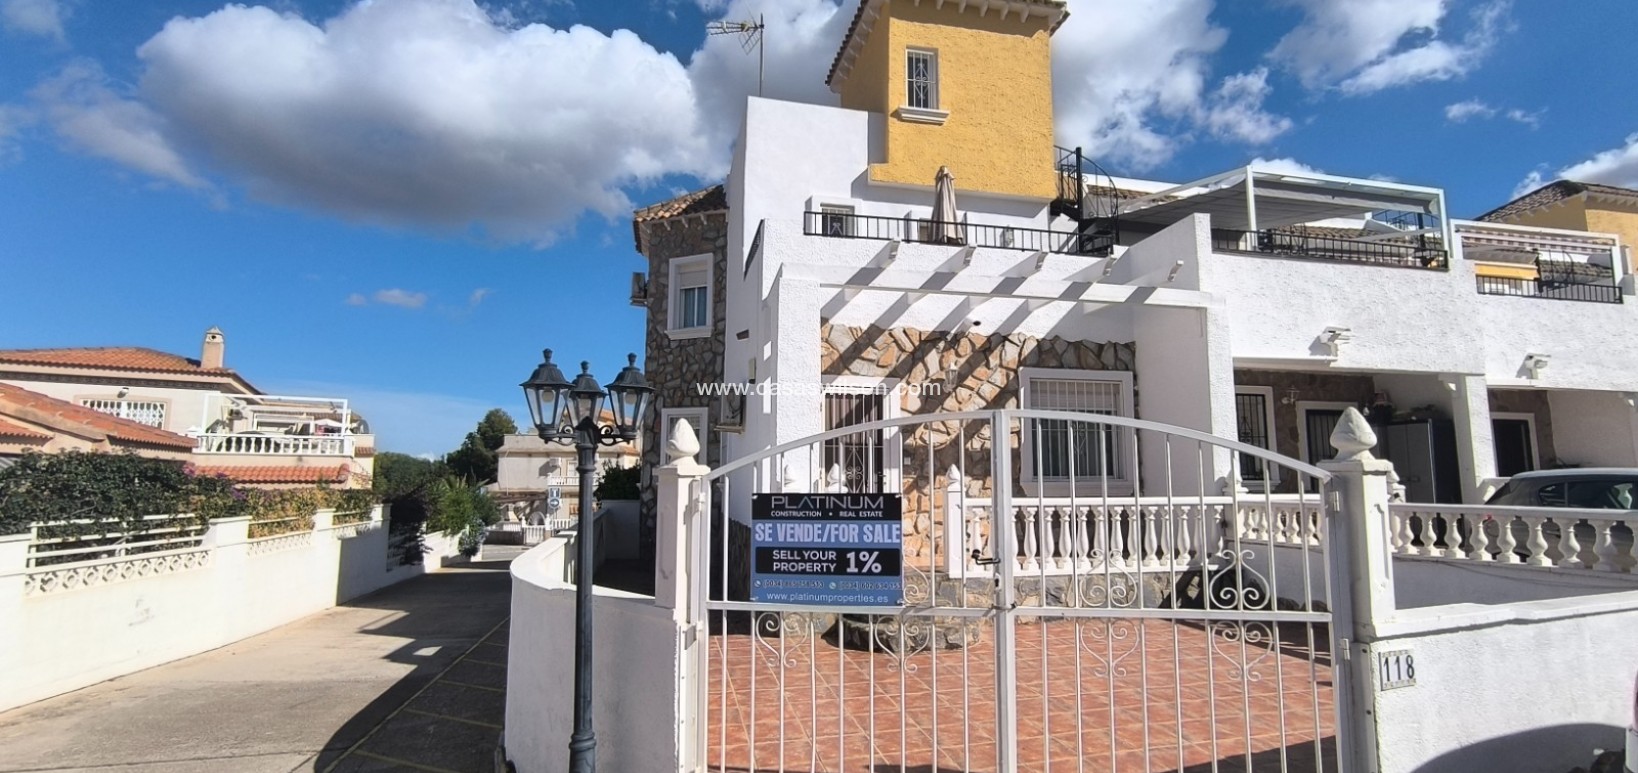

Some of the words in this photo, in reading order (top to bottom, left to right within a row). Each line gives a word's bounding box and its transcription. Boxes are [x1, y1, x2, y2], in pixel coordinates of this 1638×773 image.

[771, 495, 884, 509] PLATINUM
[770, 510, 822, 518] CONSTRUCTION
[755, 522, 773, 542] SE
[776, 523, 859, 543] VENDE/FOR
[862, 523, 901, 543] SALE
[772, 550, 801, 560] SELL
[802, 550, 837, 561] YOUR
[772, 562, 837, 573] PROPERTY
[845, 551, 882, 574] 1%
[766, 592, 889, 603] www.platinumproperties.es
[1383, 654, 1415, 682] 118
